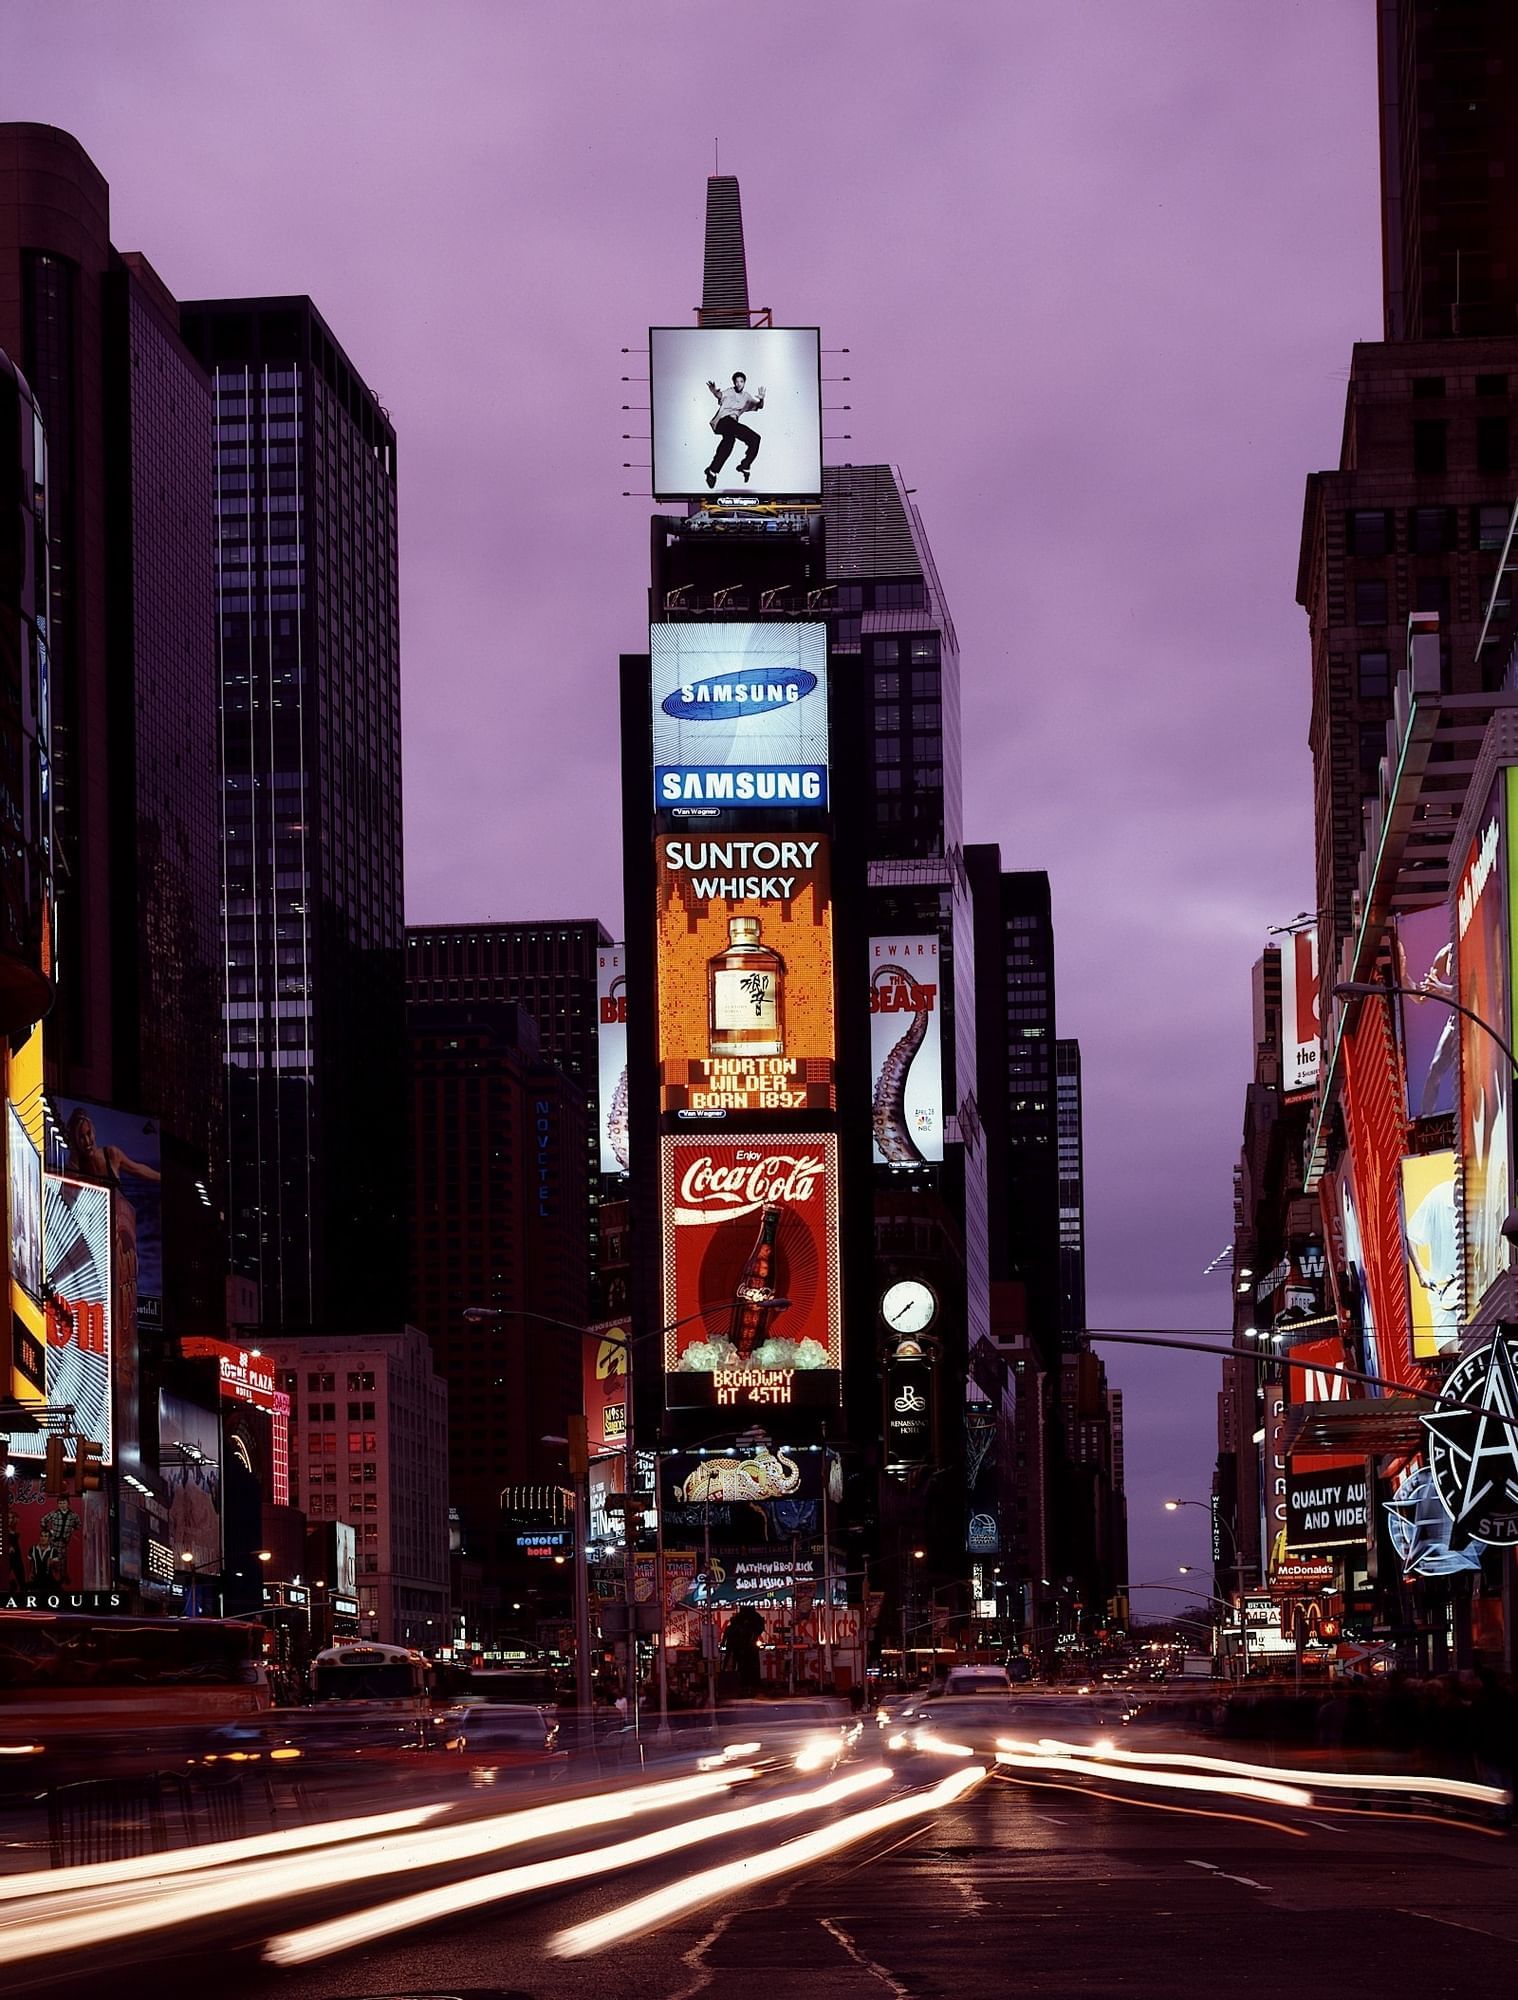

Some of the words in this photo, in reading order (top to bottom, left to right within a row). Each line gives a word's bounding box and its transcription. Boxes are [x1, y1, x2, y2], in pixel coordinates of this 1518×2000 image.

[681, 684, 799, 703] SAMSUNG
[662, 772, 820, 799] SAMSUNG
[665, 841, 819, 870] SUNTORY
[691, 877, 795, 899] WHISKY
[889, 976, 906, 985] THE
[870, 984, 937, 1013] BEAST
[1297, 1047, 1316, 1065] the
[710, 1075, 787, 1091] WILDER
[692, 1092, 747, 1109] BORN
[759, 1091, 807, 1108] 1897
[736, 1150, 762, 1161] Enjoy
[680, 1156, 825, 1203] Coca-Cola
[249, 1370, 273, 1391] PLAZA
[235, 1386, 253, 1399] HOTEL
[717, 1387, 739, 1405] AT
[748, 1386, 791, 1404] 45TH
[1291, 1486, 1342, 1509] QUALITY
[1304, 1509, 1330, 1530] AND
[516, 1534, 563, 1546] novotel
[527, 1546, 552, 1556] hotel
[667, 1563, 694, 1571] TIMES
[773, 1560, 814, 1573] BRODRICK
[1278, 1565, 1334, 1575] McDonald's
[5, 1594, 120, 1609] ARQUIS
